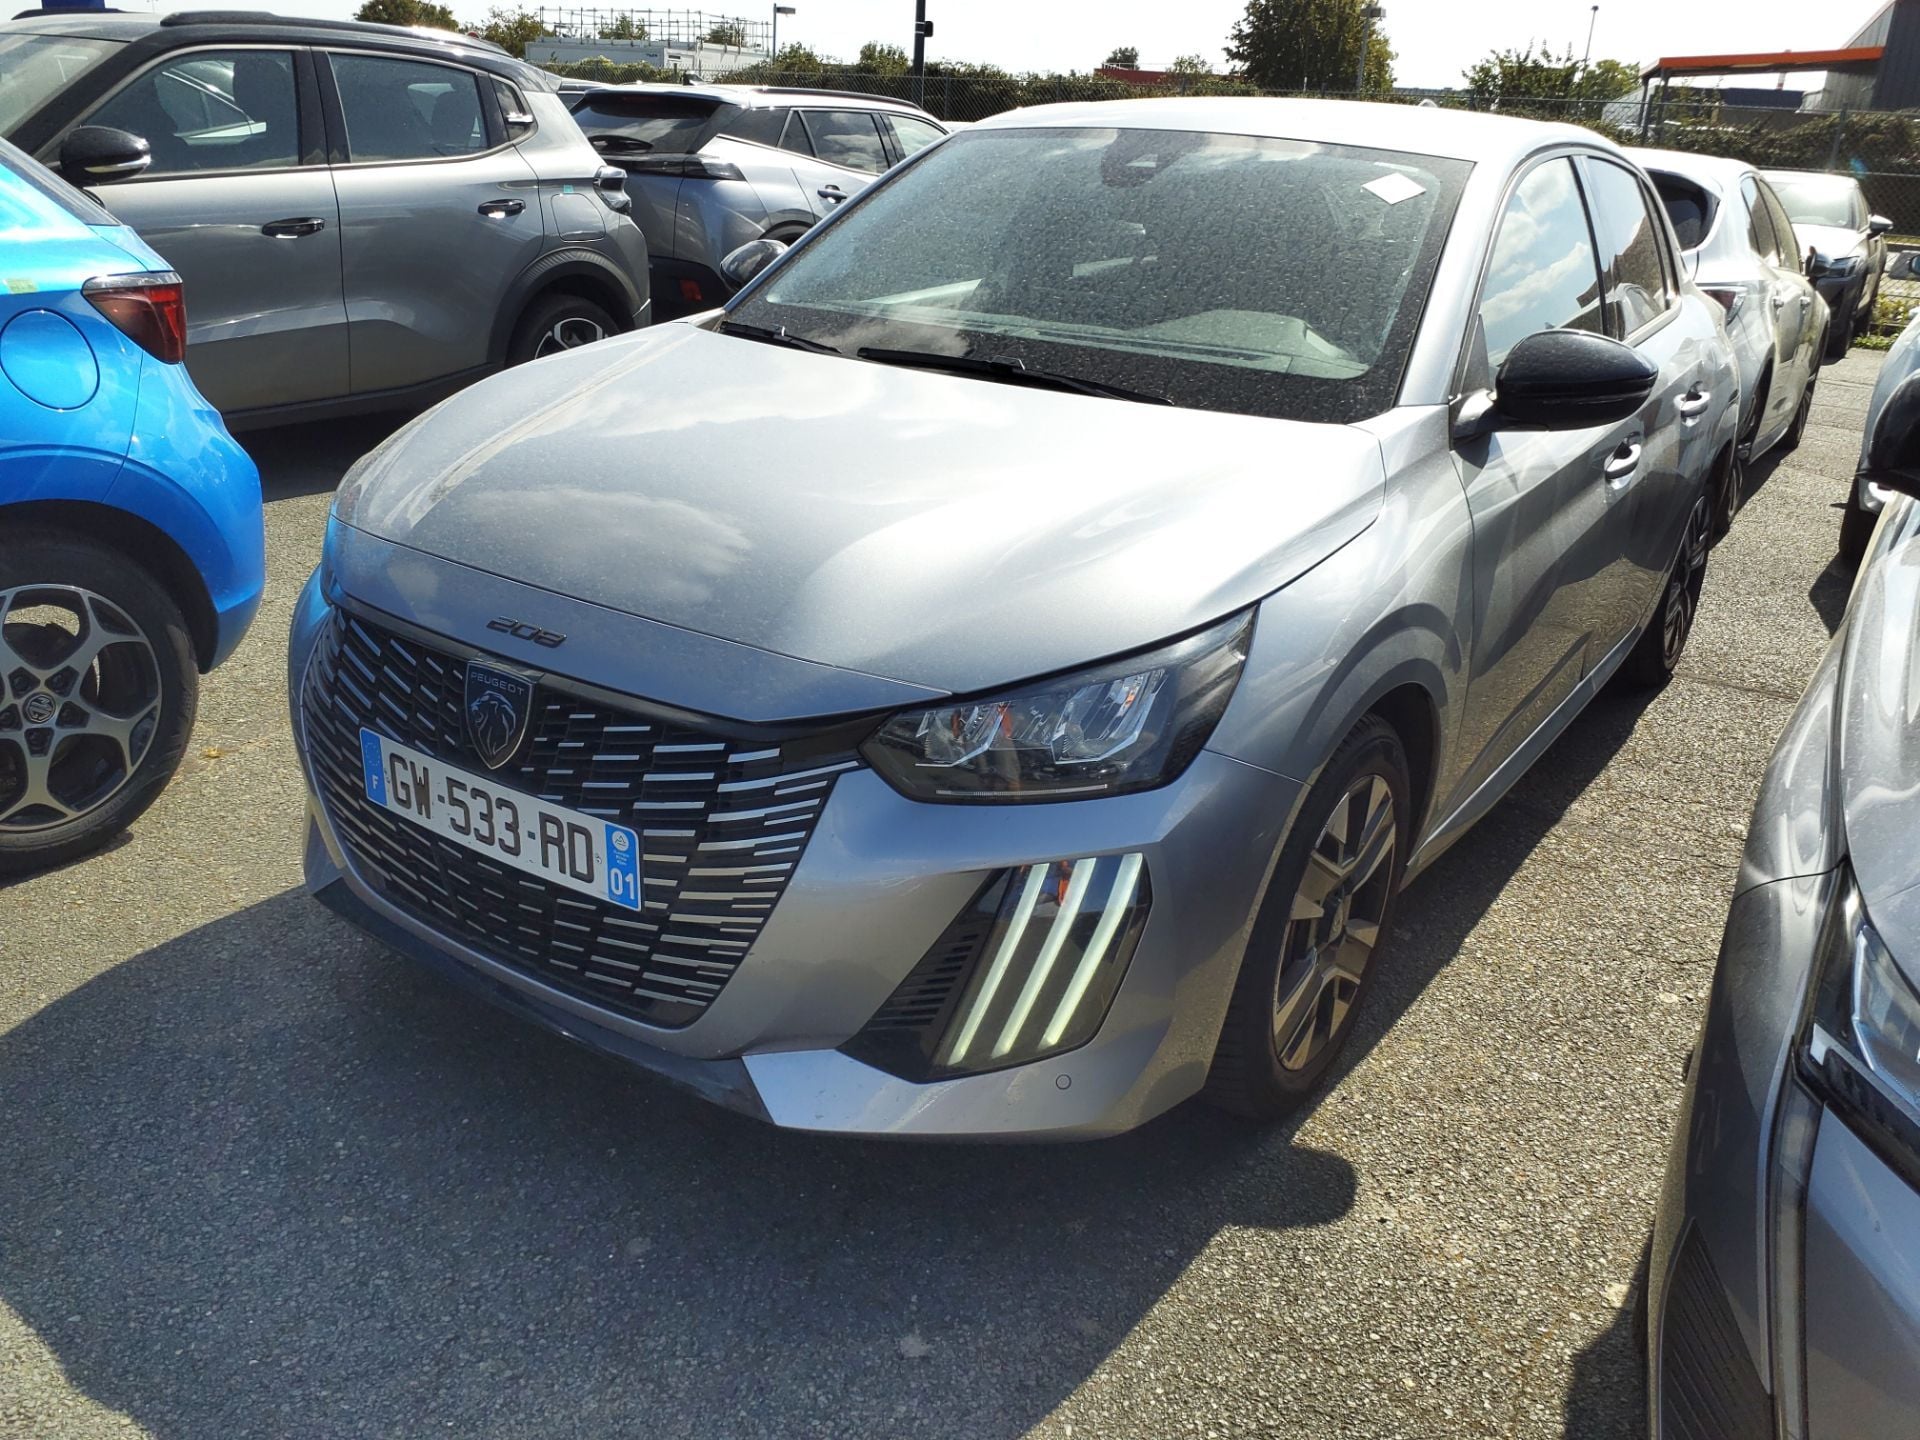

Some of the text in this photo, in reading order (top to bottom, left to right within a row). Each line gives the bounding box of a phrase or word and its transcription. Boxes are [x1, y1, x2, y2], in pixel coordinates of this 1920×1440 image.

[485, 615, 567, 649] 208
[470, 671, 525, 696] PEUGEOT
[371, 774, 379, 790] F
[389, 752, 595, 884] GW-533-RD
[610, 867, 635, 900] 01
